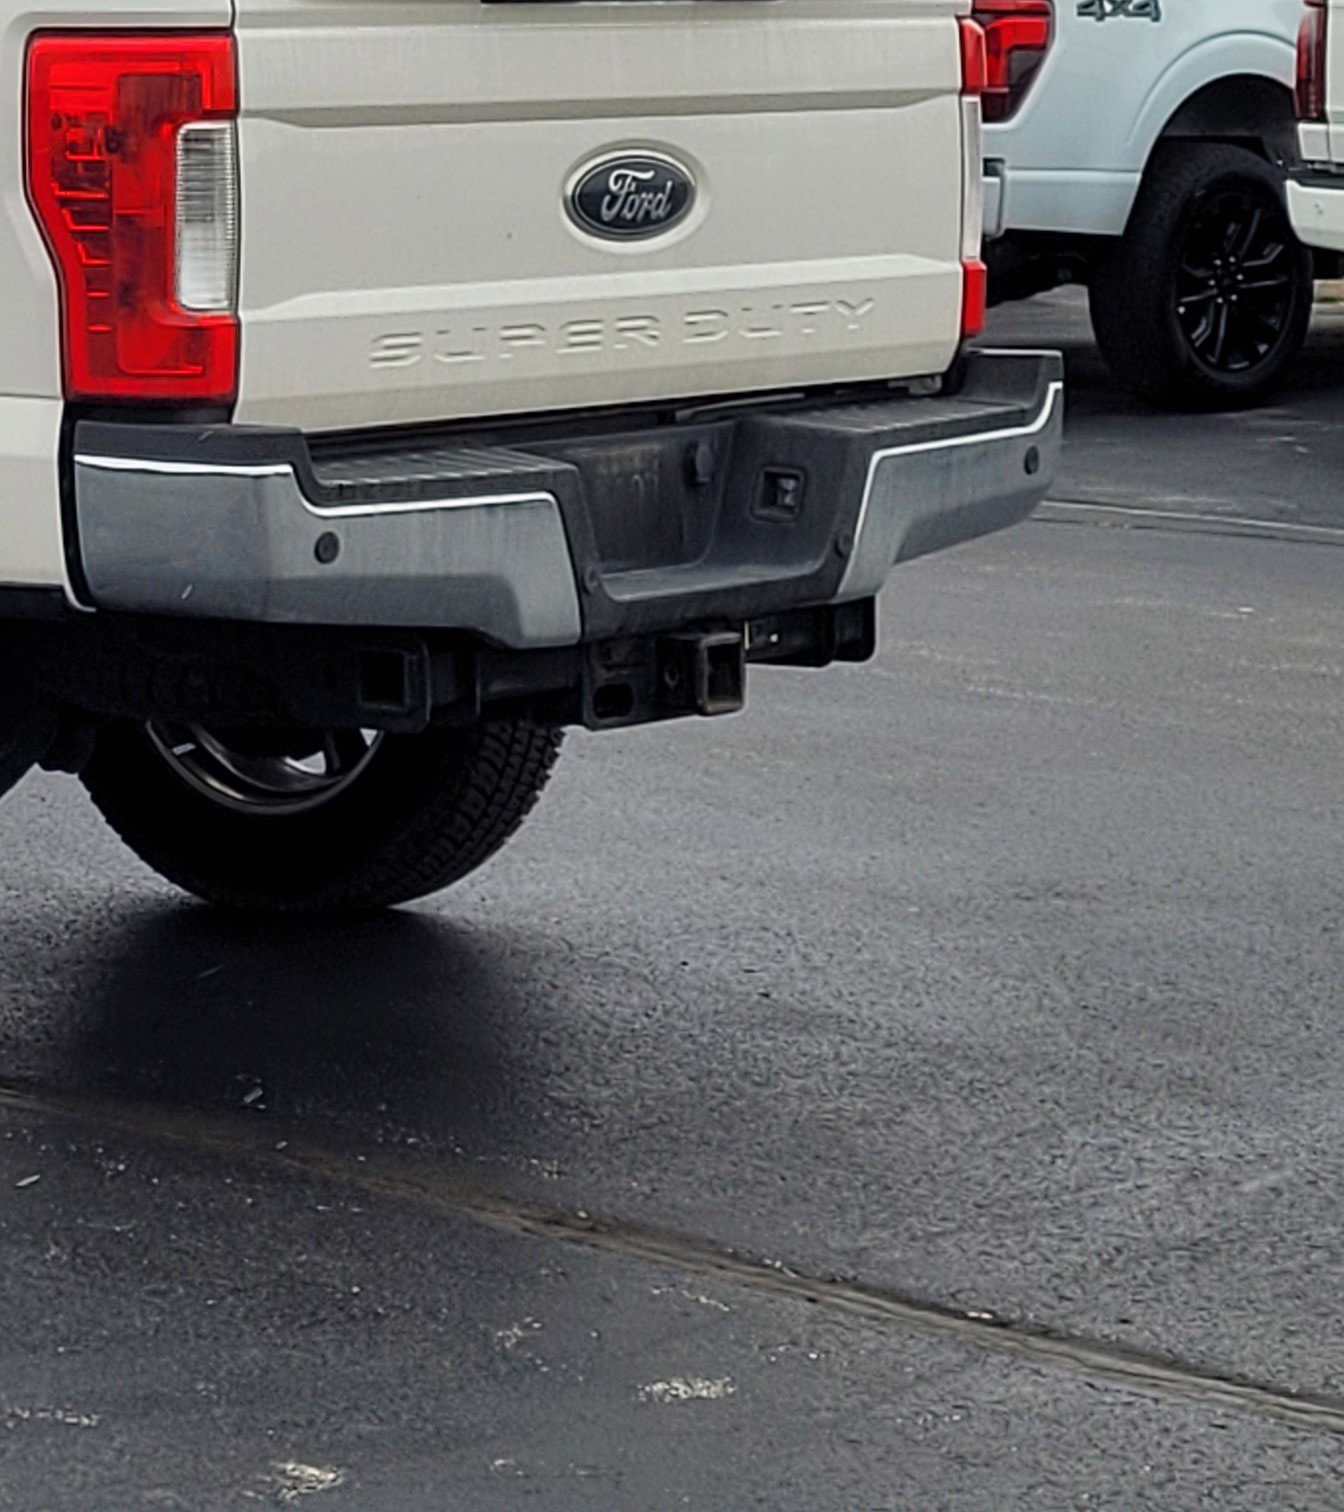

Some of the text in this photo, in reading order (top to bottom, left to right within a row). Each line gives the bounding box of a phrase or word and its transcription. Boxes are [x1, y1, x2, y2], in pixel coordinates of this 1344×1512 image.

[600, 168, 674, 224] Ford
[368, 297, 875, 369] SUPER DUTY
